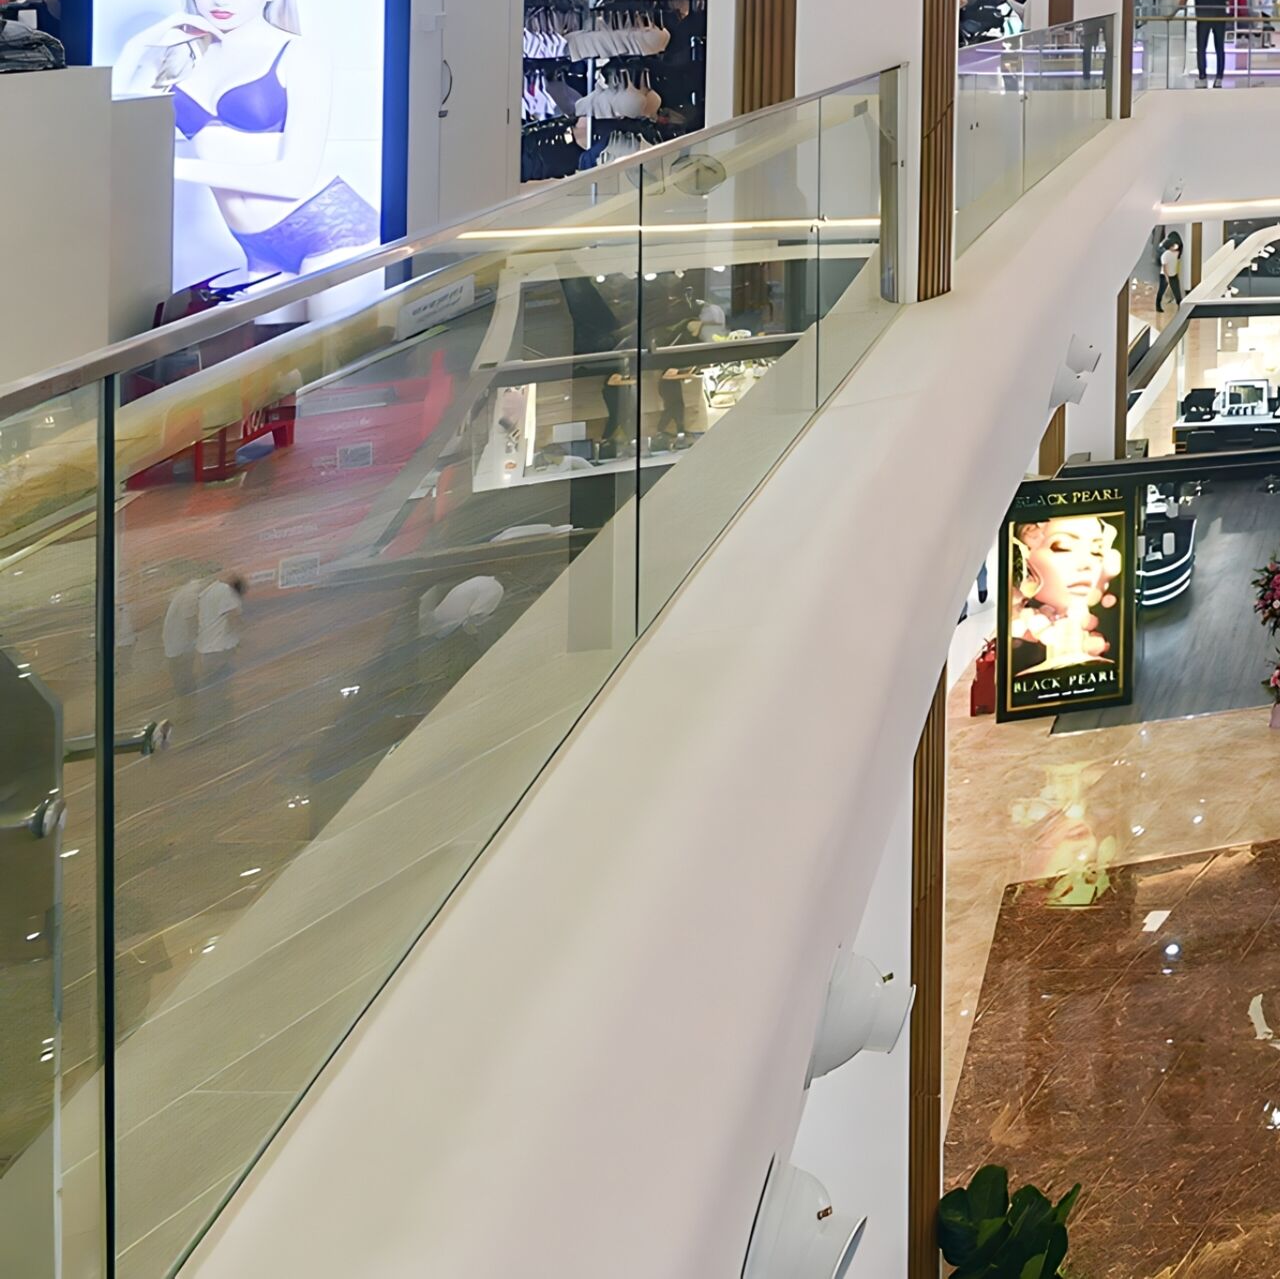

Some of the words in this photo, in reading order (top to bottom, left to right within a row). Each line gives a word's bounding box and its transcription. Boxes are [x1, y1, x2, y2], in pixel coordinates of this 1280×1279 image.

[1072, 488, 1124, 504] PEARL
[1013, 676, 1061, 693] BLACK
[1069, 669, 1116, 687] PEARL
